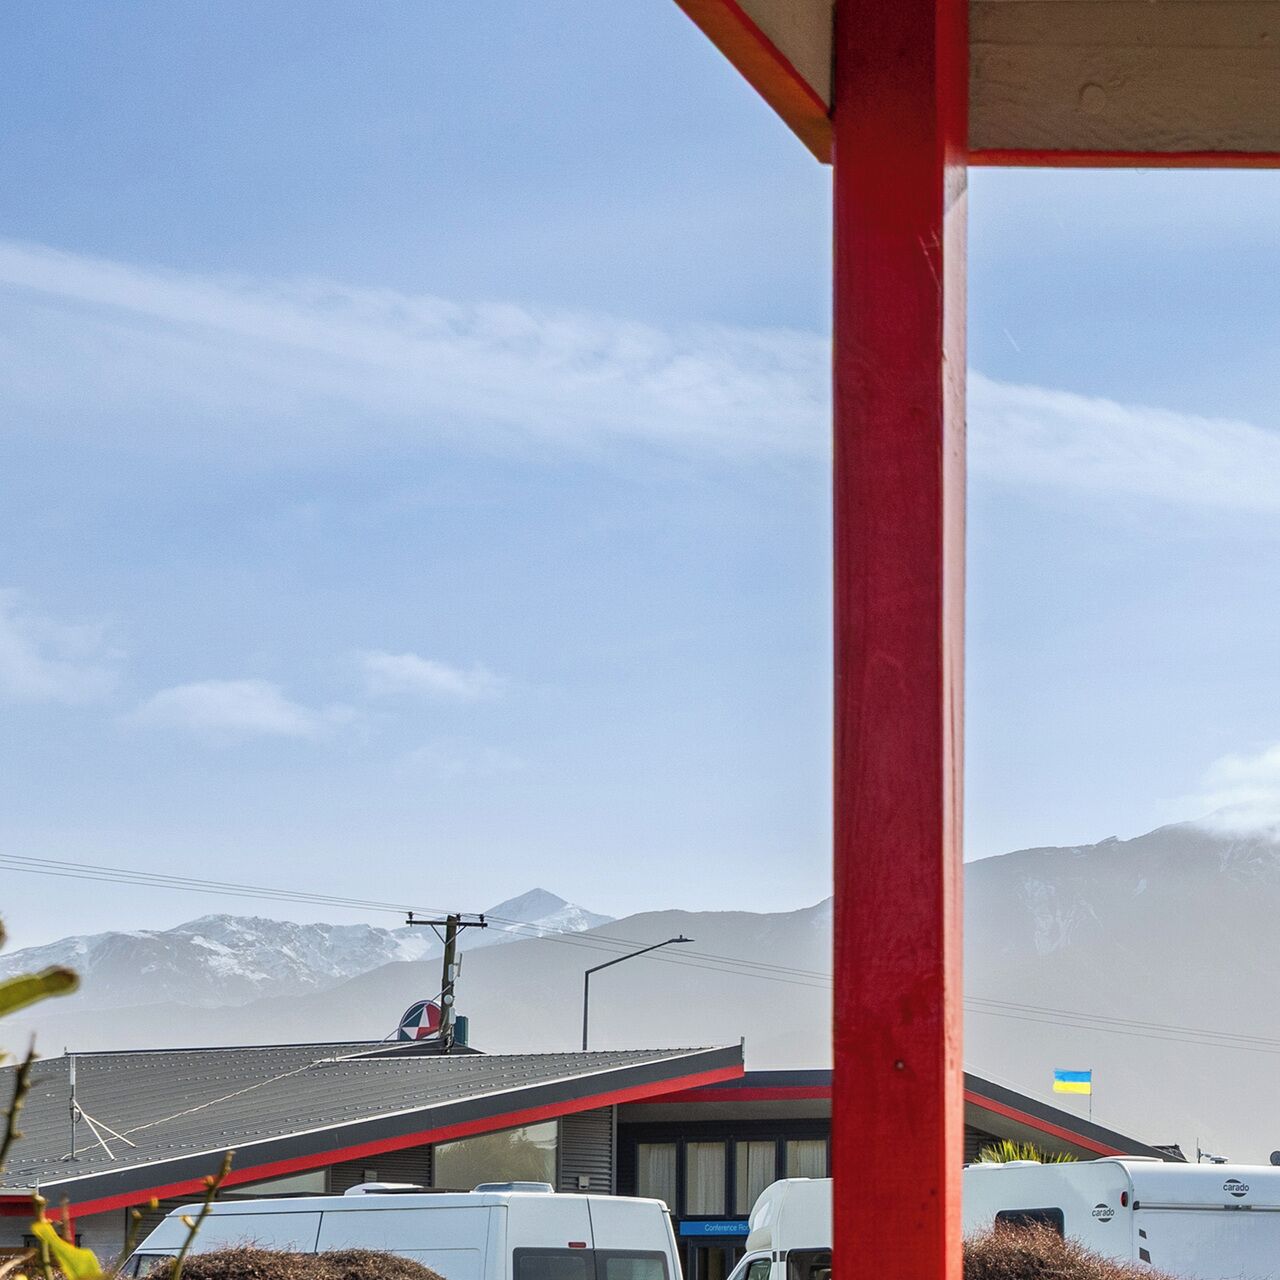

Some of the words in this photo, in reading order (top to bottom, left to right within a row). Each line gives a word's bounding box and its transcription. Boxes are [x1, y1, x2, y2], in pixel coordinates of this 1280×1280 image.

[1223, 1182, 1250, 1192] carado
[1091, 1207, 1115, 1217] carado
[704, 1223, 738, 1232] Conference
